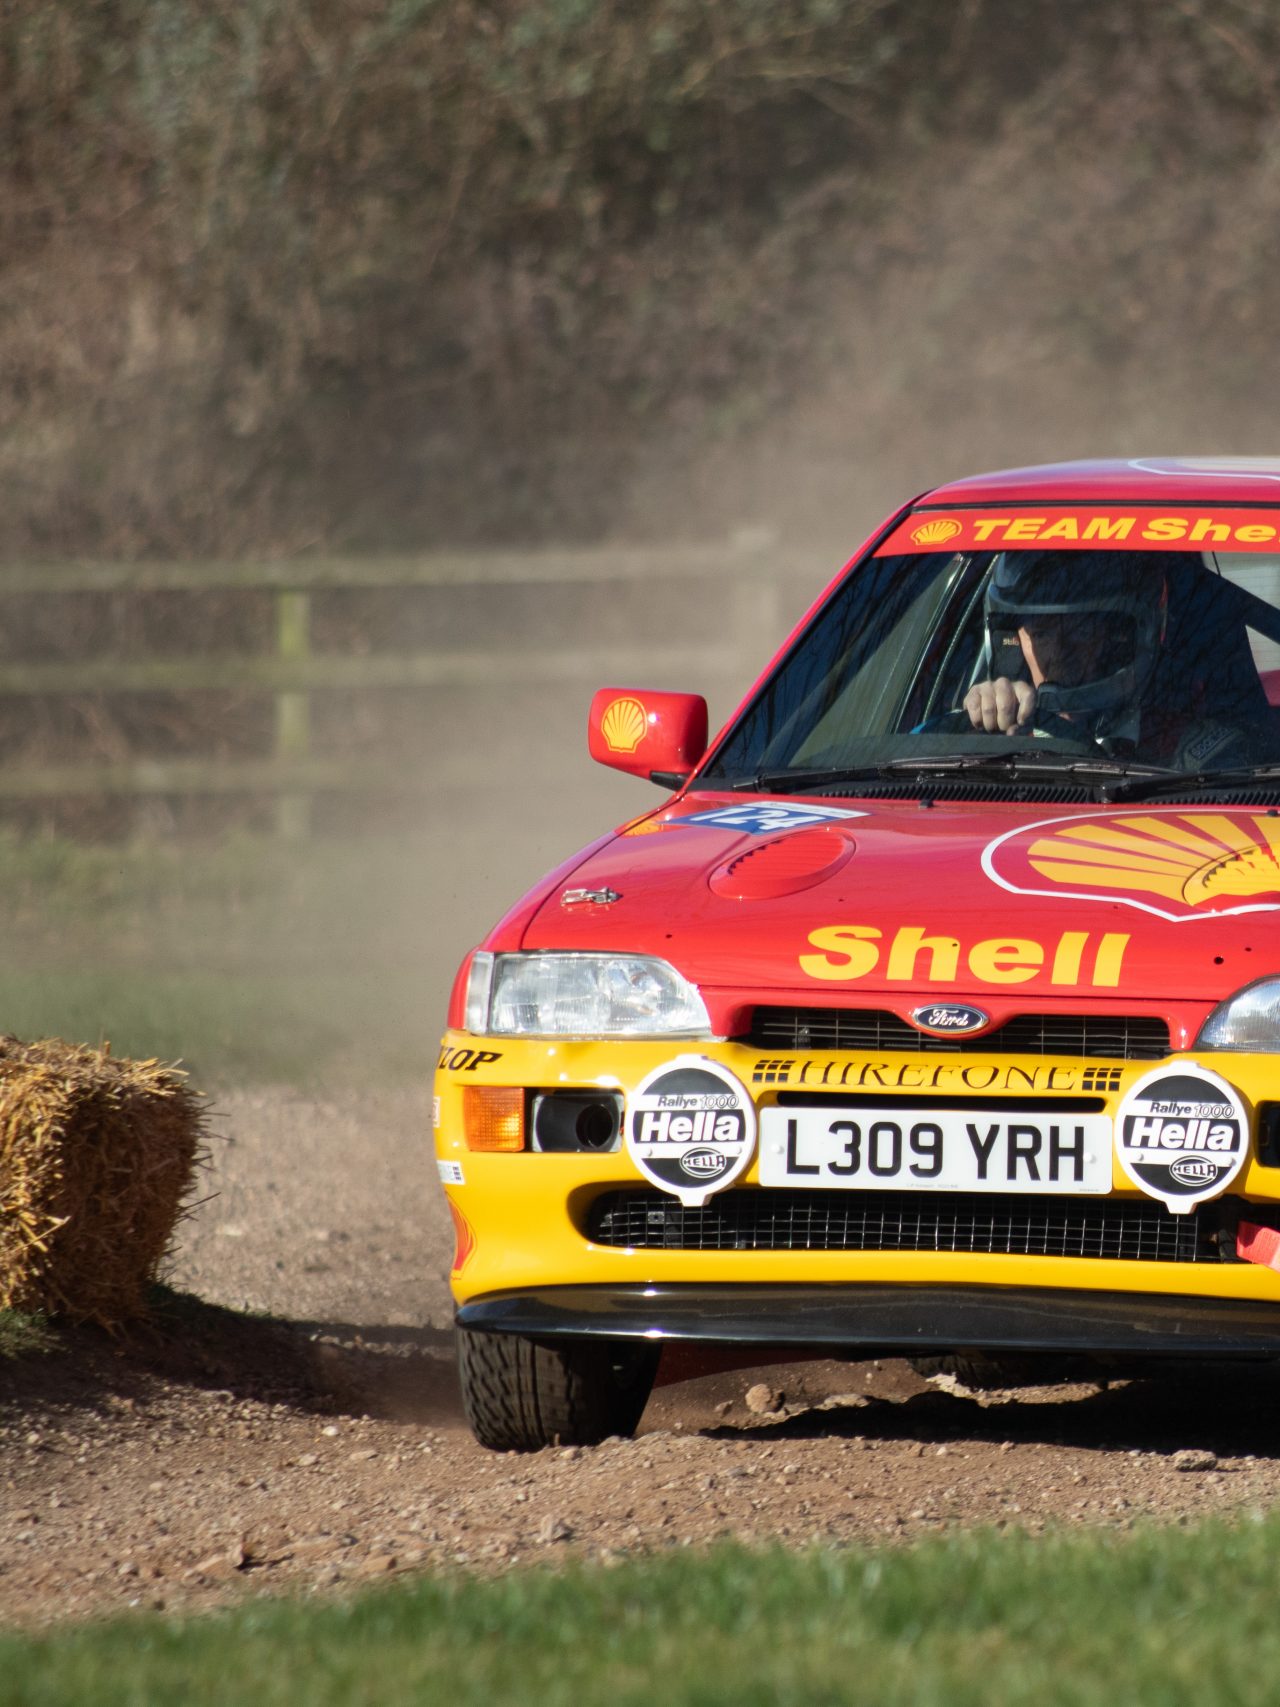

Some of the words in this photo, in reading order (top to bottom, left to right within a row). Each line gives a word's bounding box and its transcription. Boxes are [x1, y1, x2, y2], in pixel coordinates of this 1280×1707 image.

[973, 518, 1137, 541] TEAM
[689, 807, 827, 830] 124
[799, 925, 1131, 987] Shell
[928, 1008, 969, 1026] Ford
[438, 1046, 503, 1071] LOP
[795, 1060, 1076, 1090] HIREFONE
[658, 1096, 698, 1109] Rallye
[699, 1094, 739, 1109] 1000
[1150, 1102, 1192, 1116] Rallye
[1193, 1104, 1235, 1118] 1000
[640, 1111, 740, 1142] Hella
[1130, 1117, 1234, 1151] Hella
[683, 1155, 725, 1167] HELLA
[786, 1119, 944, 1178] L309
[966, 1123, 1085, 1182] YRH
[1173, 1164, 1217, 1177] HELLA
